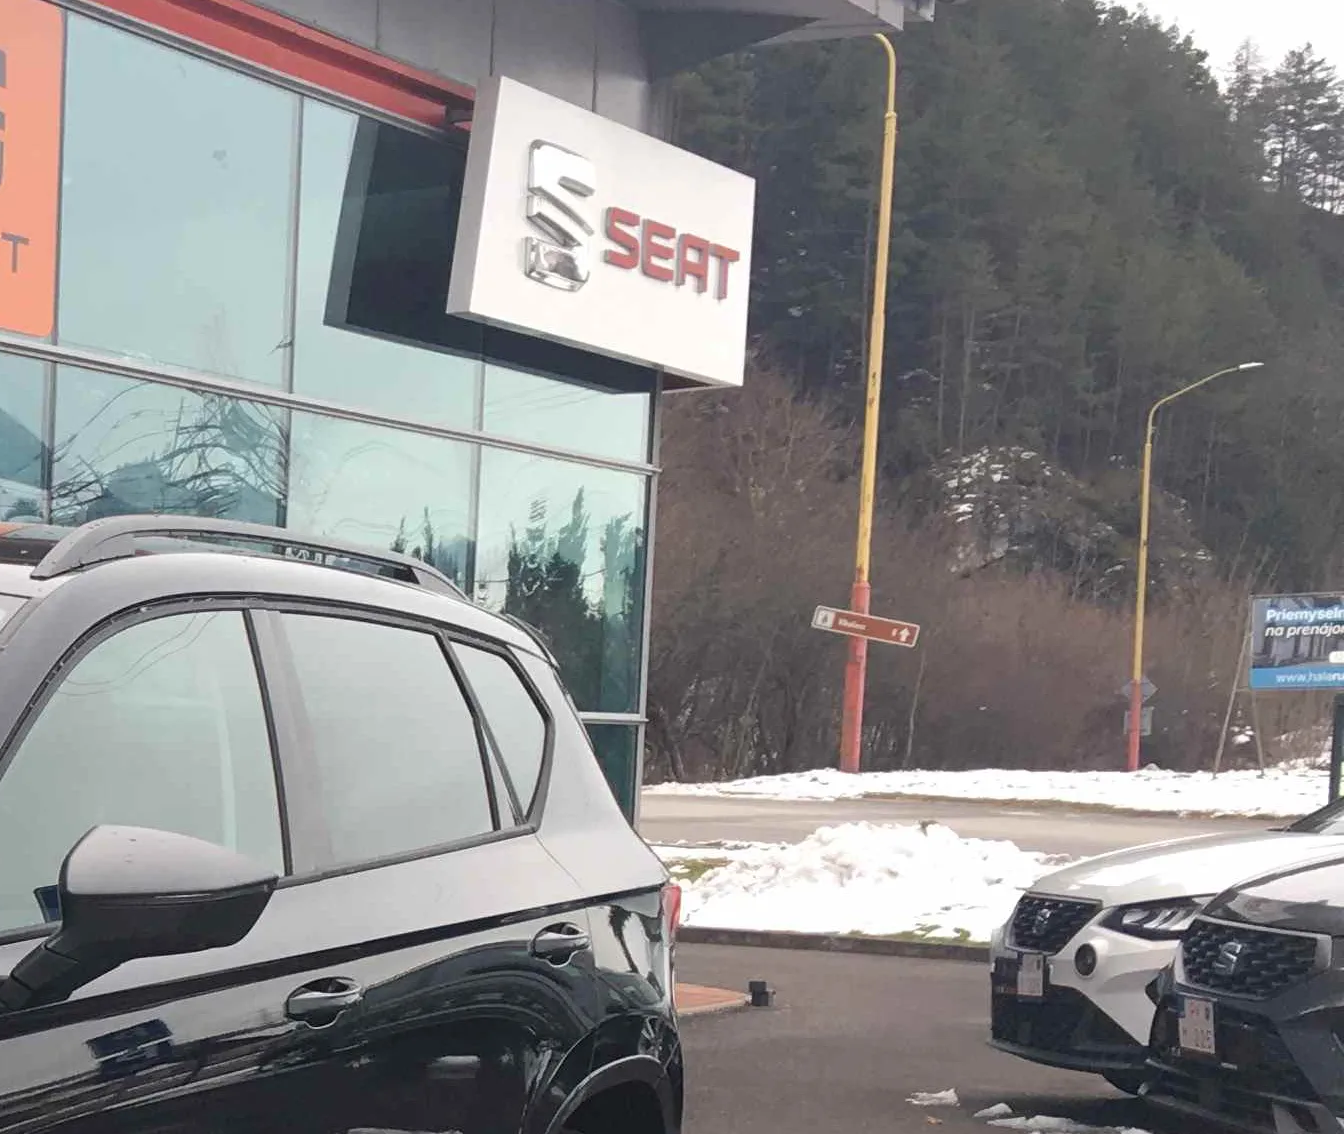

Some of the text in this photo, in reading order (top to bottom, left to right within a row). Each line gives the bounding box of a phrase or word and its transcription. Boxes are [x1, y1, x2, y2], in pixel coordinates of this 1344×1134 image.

[602, 205, 741, 301] SEAT
[1264, 622, 1344, 638] na prenájo
